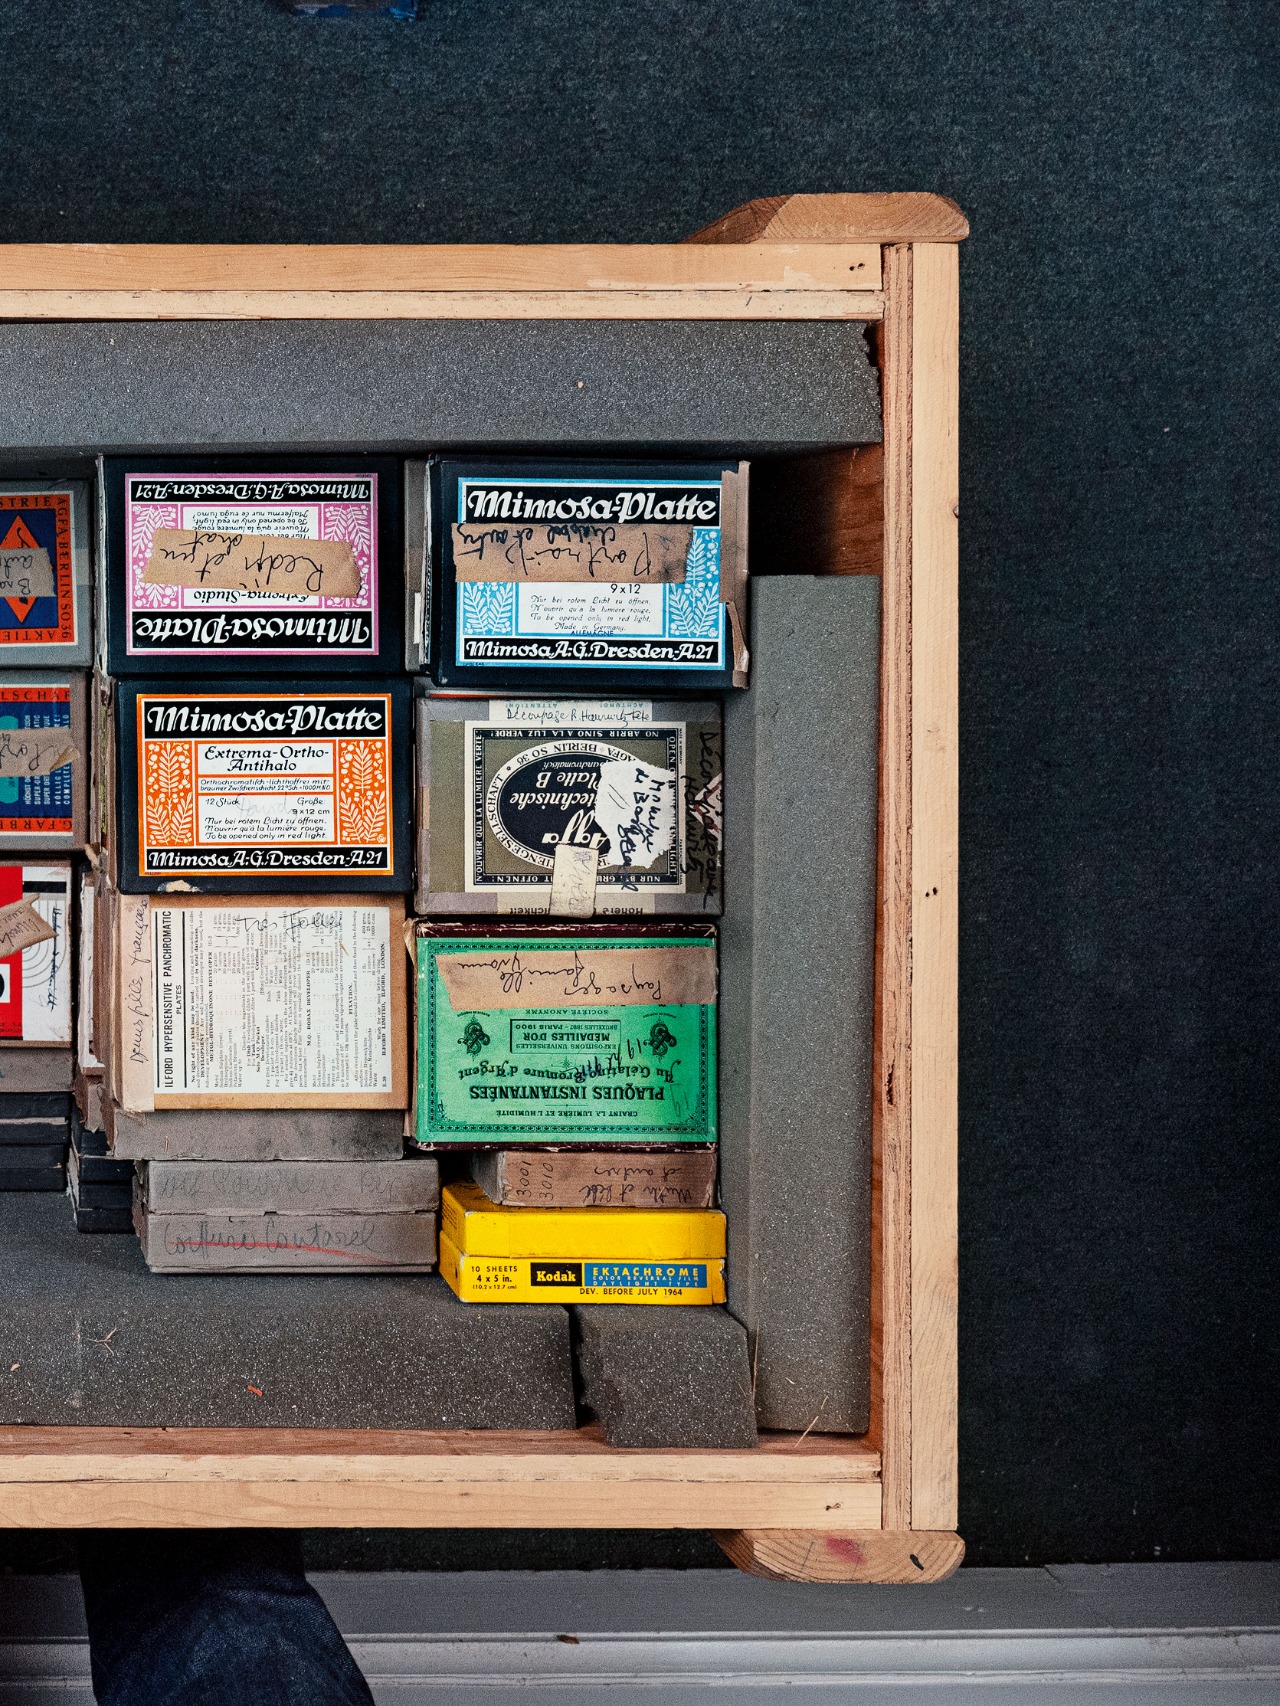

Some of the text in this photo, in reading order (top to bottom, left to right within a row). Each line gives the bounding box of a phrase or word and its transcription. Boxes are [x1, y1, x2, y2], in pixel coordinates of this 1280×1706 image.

[467, 490, 717, 523] Mimosa-Platte
[196, 554, 225, 582] et
[194, 590, 310, 602] Extrema-Studio
[610, 584, 618, 593] 9
[629, 584, 641, 594] 12
[136, 614, 370, 644] Mimosa-Platte
[147, 704, 382, 734] Mimosa-Platte
[205, 746, 329, 760] Extrema-Ortho-
[516, 743, 598, 764] BERLIN SO 36
[227, 759, 297, 771] Antihalo
[536, 772, 552, 786] B
[297, 817, 327, 825] öffnen.
[205, 832, 217, 840] To
[229, 832, 257, 840] opened
[162, 911, 173, 1088] ILFORD HYPERSENSITIVE PANCHROMATIC
[525, 1008, 567, 1016] ANONYME
[523, 1033, 610, 1042] MÉDAILLES D'OR
[457, 1060, 518, 1080] d'Argent
[469, 1084, 665, 1102] PLAQUES INSTANTANÉES
[536, 1271, 576, 1282] Kodak
[593, 1268, 698, 1276] EKTACHROME
